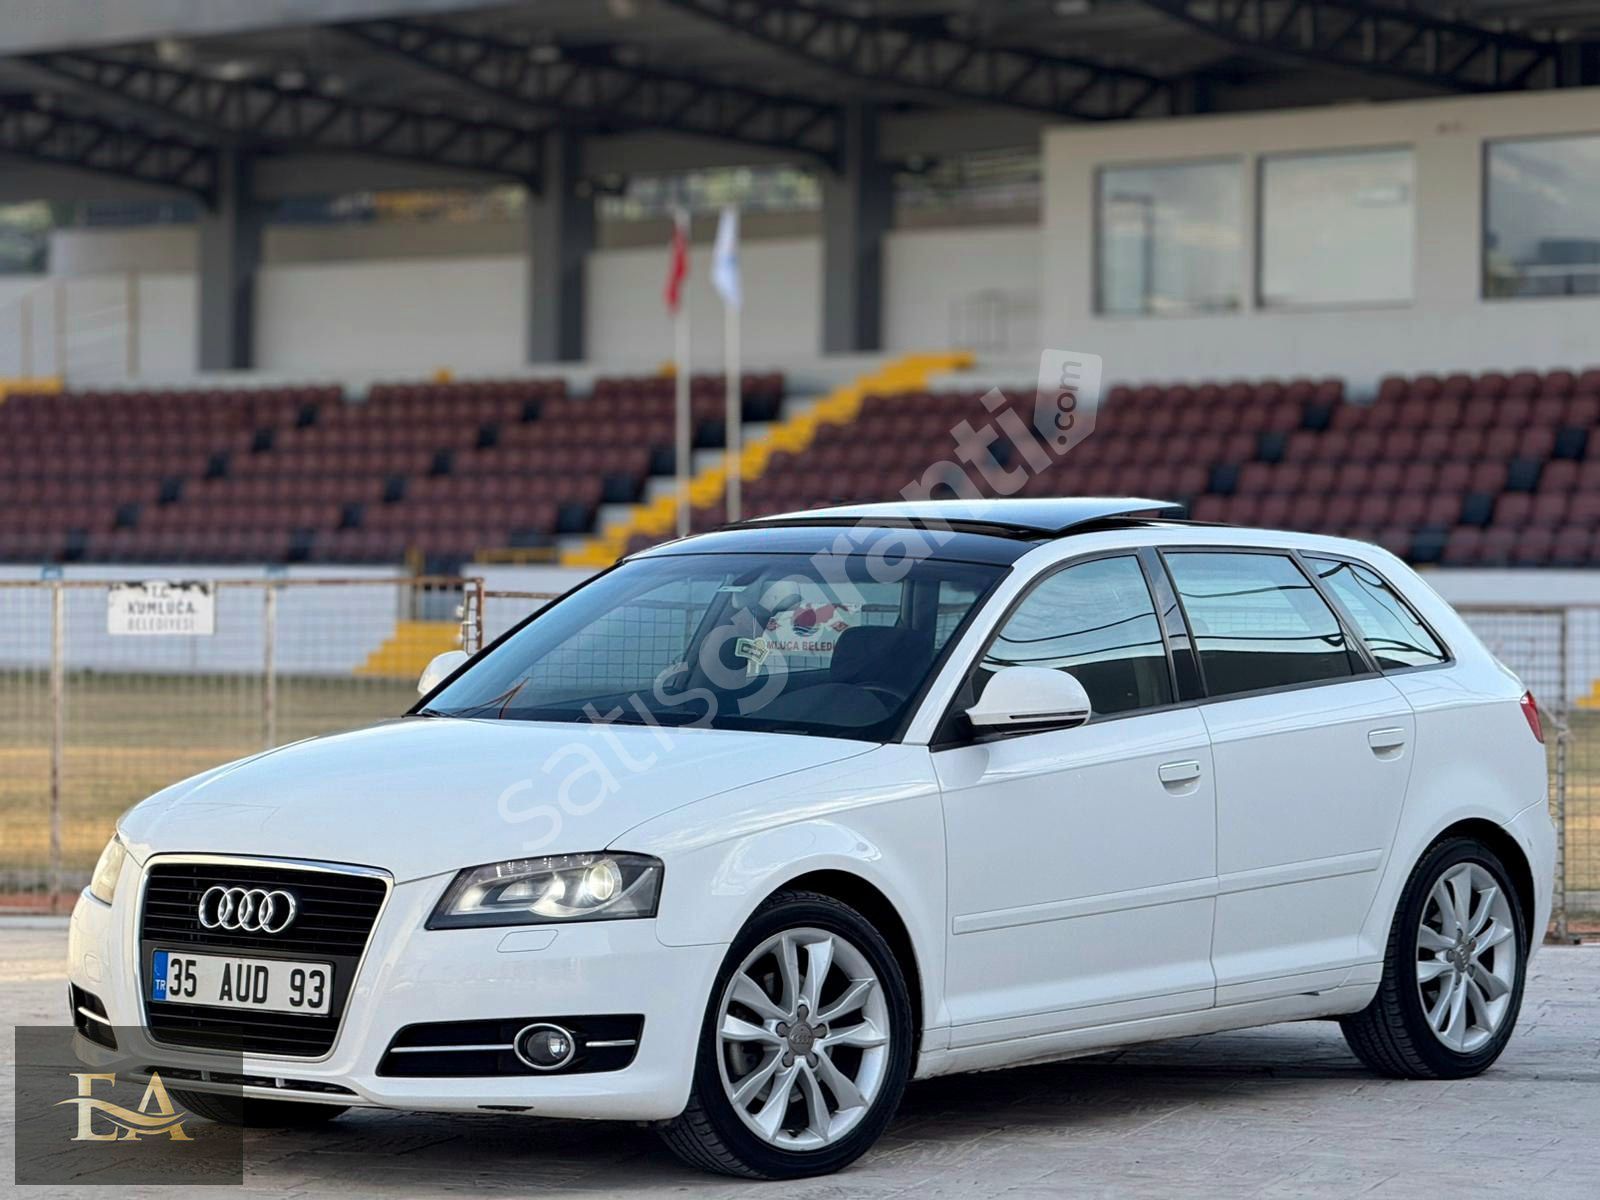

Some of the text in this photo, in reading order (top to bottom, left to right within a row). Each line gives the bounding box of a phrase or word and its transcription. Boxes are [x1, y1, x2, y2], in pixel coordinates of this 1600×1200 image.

[127, 601, 196, 615] KUMLUCA
[155, 979, 167, 991] TR
[169, 958, 325, 1009] 35 AUD 93
